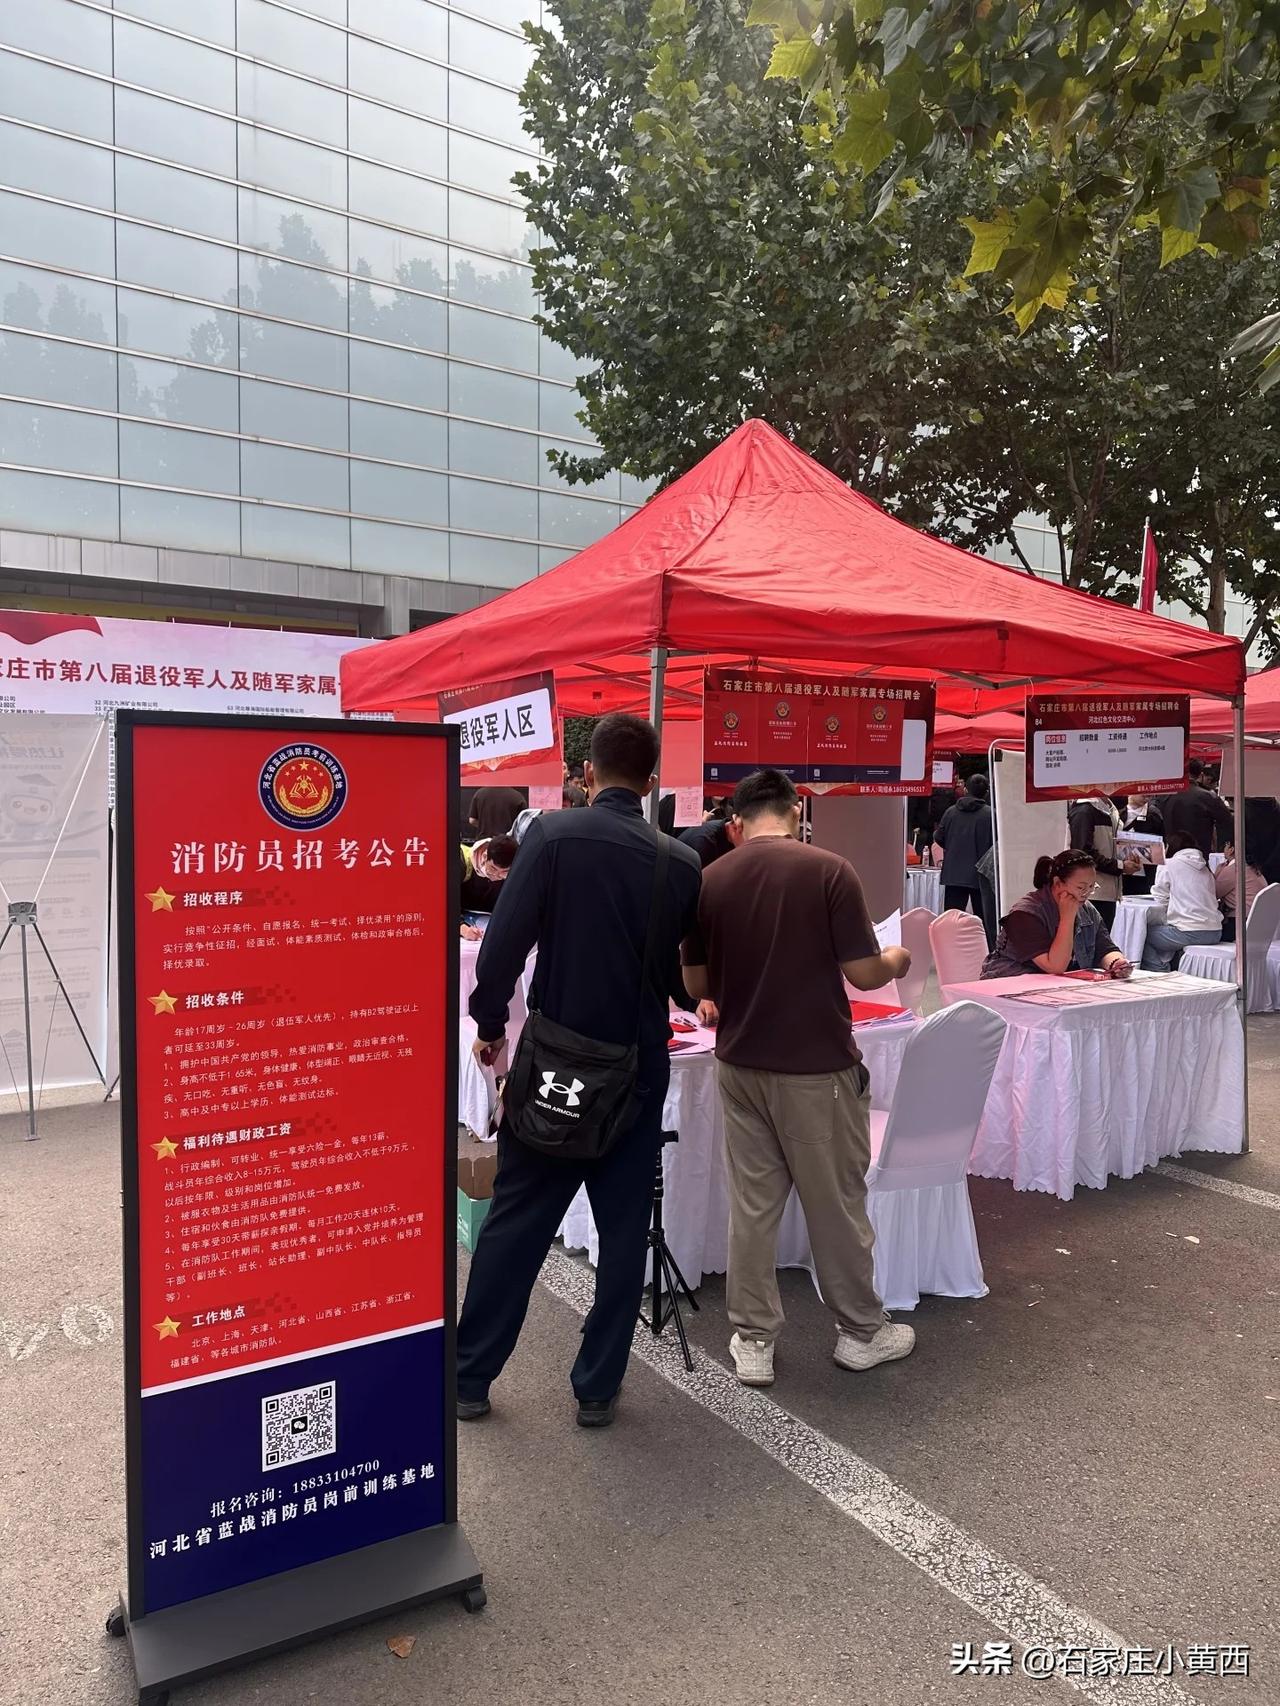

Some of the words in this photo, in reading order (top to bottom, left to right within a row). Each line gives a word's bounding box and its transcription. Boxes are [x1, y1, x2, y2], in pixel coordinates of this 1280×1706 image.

[0, 657, 341, 695] 庄市第八届退役军人及随军家属
[723, 680, 921, 700] 石家庄市第八届退役军人及随军家属专场招聘会
[1039, 701, 1181, 713] 石家庄市第八届退役军人及随军家属专场招聘会
[1139, 731, 1158, 740] 工作地点
[170, 837, 430, 874] 消防员招考公告
[183, 890, 243, 908] 招收程序
[185, 990, 245, 1009] 招收条件
[553, 1106, 579, 1118] ARMOUR
[182, 1122, 292, 1151] 福利待遇财政工资
[192, 1305, 246, 1327] 工作地点
[150, 1462, 436, 1559] 河北省蓝战消防员岗前训练基地
